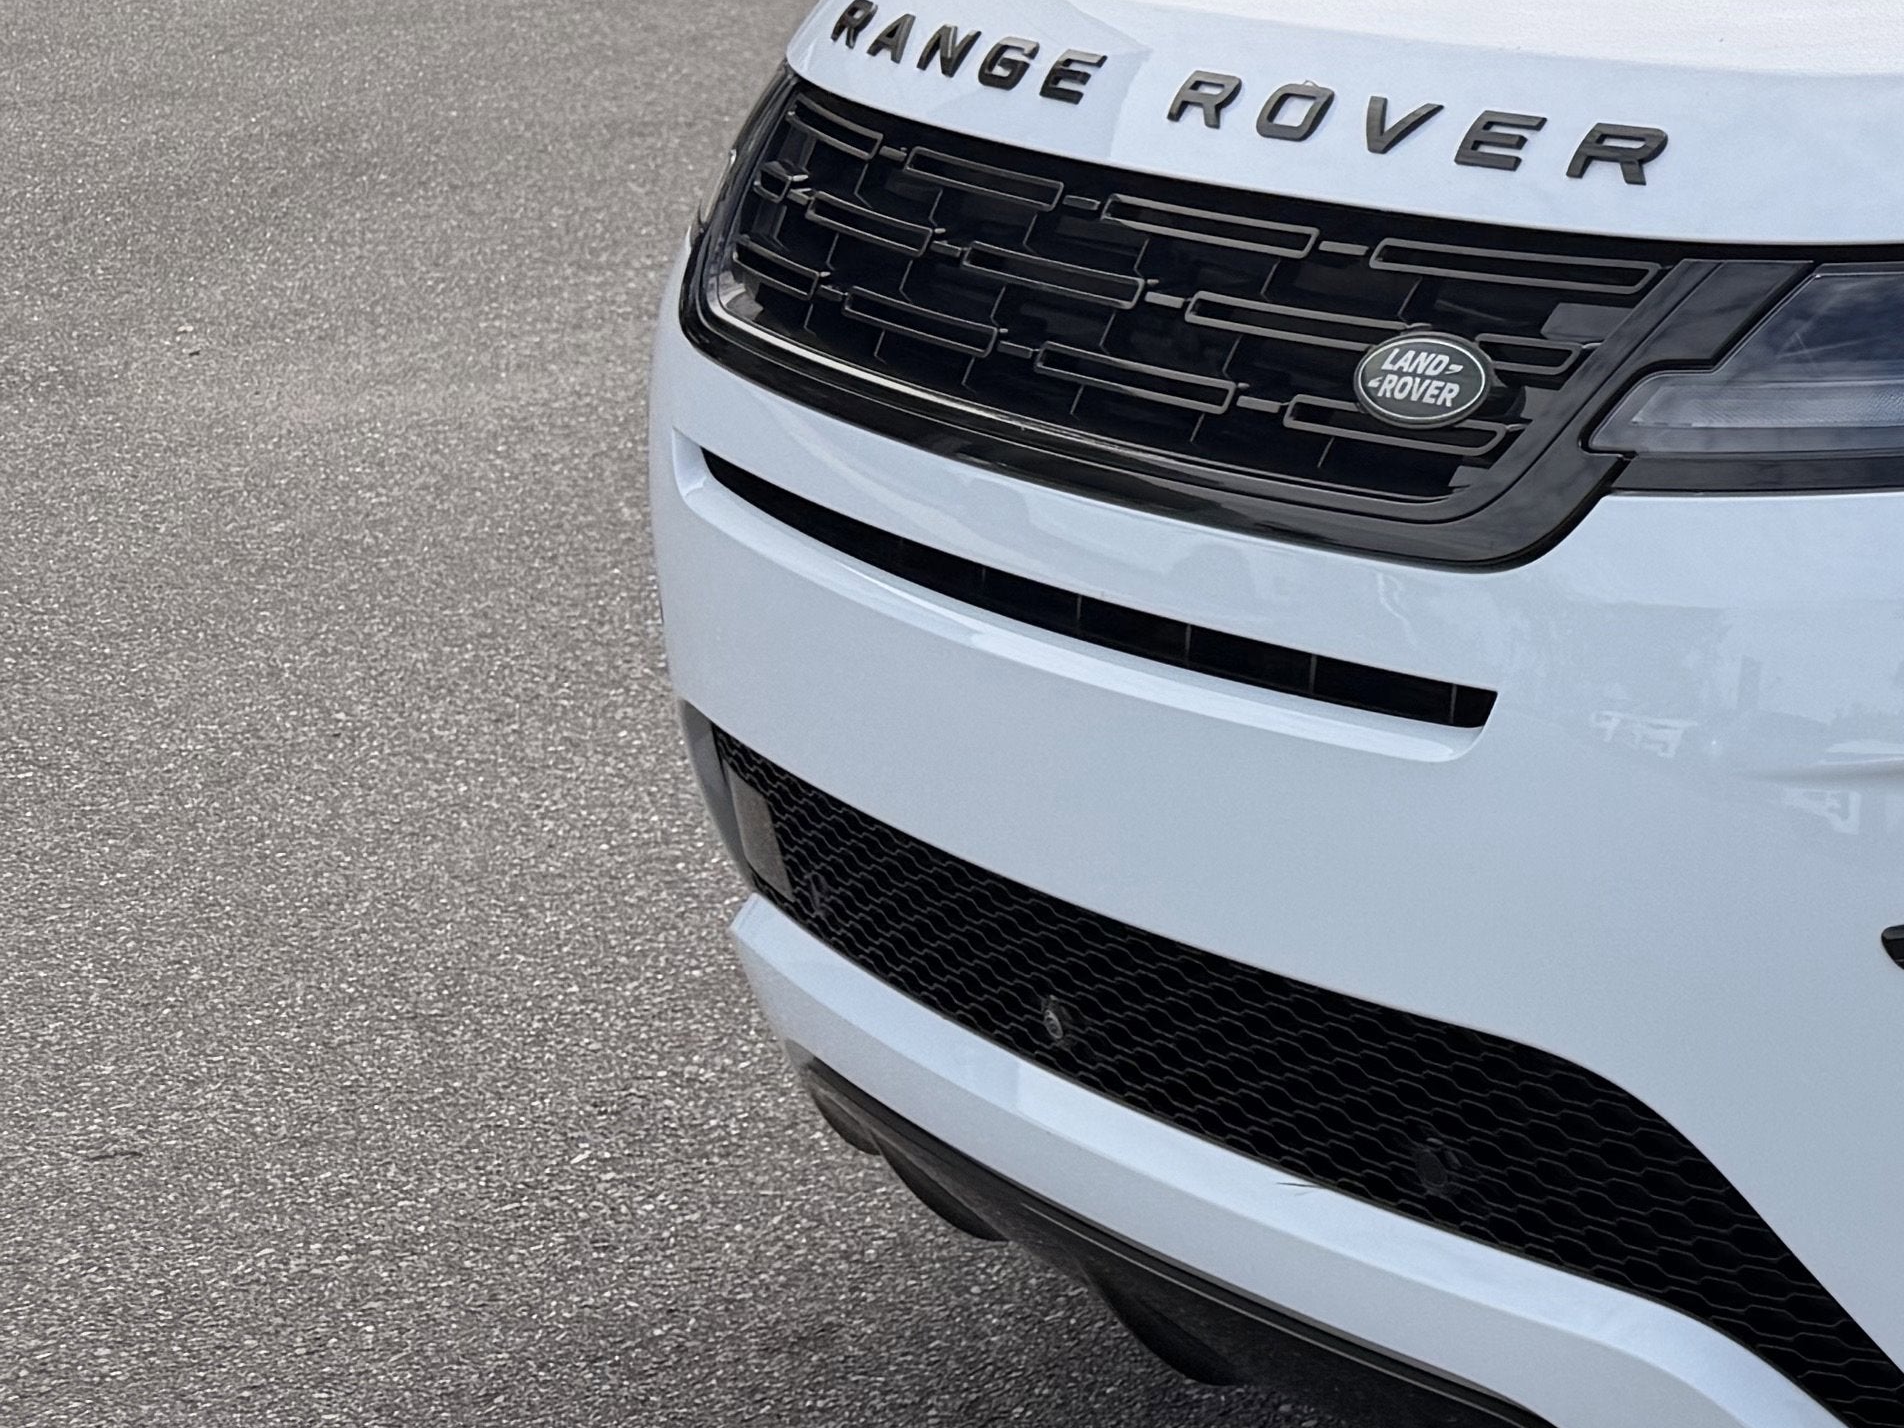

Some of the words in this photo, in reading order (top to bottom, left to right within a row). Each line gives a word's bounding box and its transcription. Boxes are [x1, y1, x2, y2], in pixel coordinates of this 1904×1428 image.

[1167, 69, 1669, 185] ROVER
[1381, 348, 1450, 376] LAND
[1377, 373, 1460, 407] ROVER
